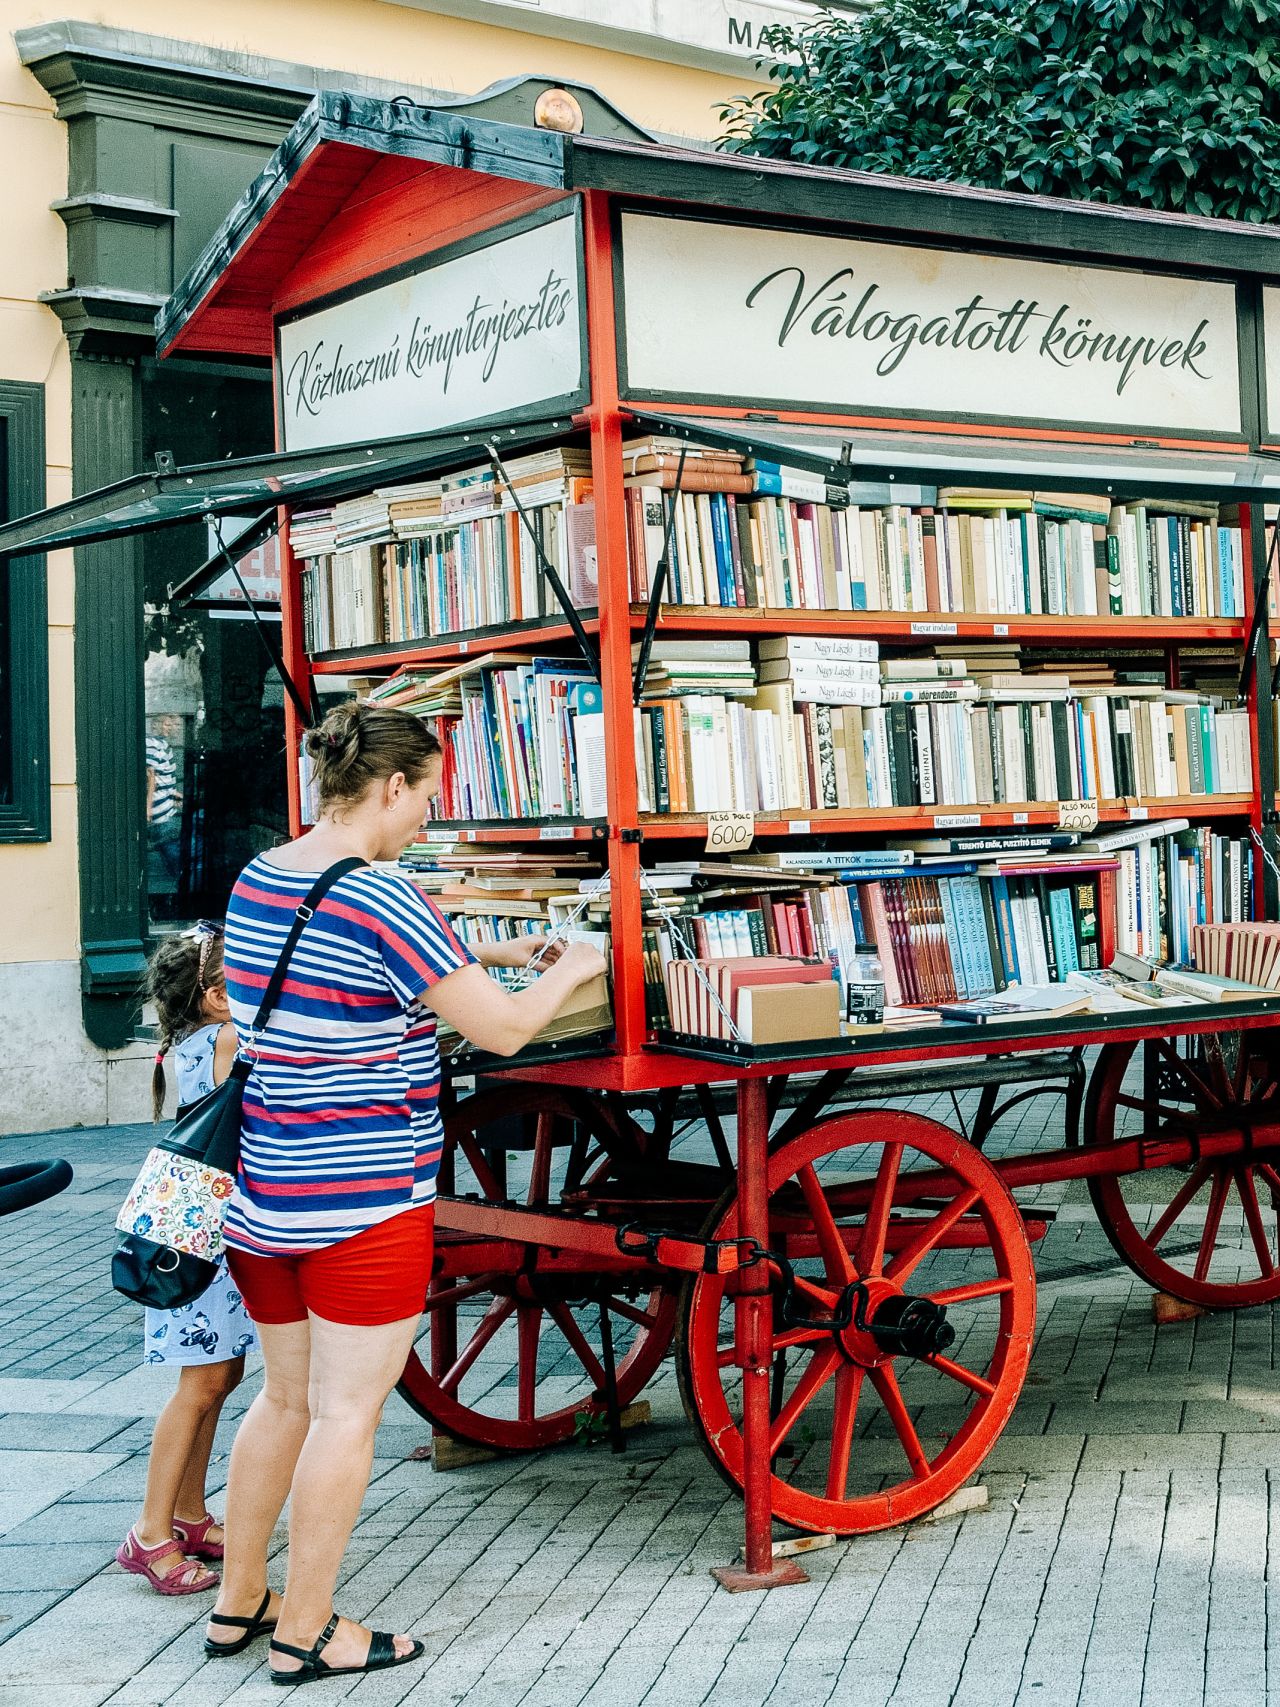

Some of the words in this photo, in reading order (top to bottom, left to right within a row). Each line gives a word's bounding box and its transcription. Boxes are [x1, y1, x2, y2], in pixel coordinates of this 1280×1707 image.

[746, 266, 1050, 378] Válogatott
[1039, 304, 1212, 396] könyvek
[287, 334, 401, 417] Közhasznú
[406, 269, 574, 395] könyvterjesztés
[912, 623, 931, 634] Magyar
[933, 623, 956, 633] irodalom
[814, 641, 831, 656] Nagy
[833, 641, 853, 654] László
[816, 663, 833, 677] Nagy
[834, 663, 855, 676] László
[819, 685, 835, 698] Nagy
[836, 685, 857, 698] László
[922, 747, 931, 794] KÖRHINTA
[659, 768, 667, 787] Konrád
[1062, 803, 1078, 811] ALSÓ
[710, 813, 729, 821] ALSÓ
[936, 817, 955, 827] Magyar
[956, 816, 979, 825] irodalom
[958, 841, 984, 850] TEREMTŐ
[826, 856, 832, 864] A
[834, 856, 861, 864] TITKOK
